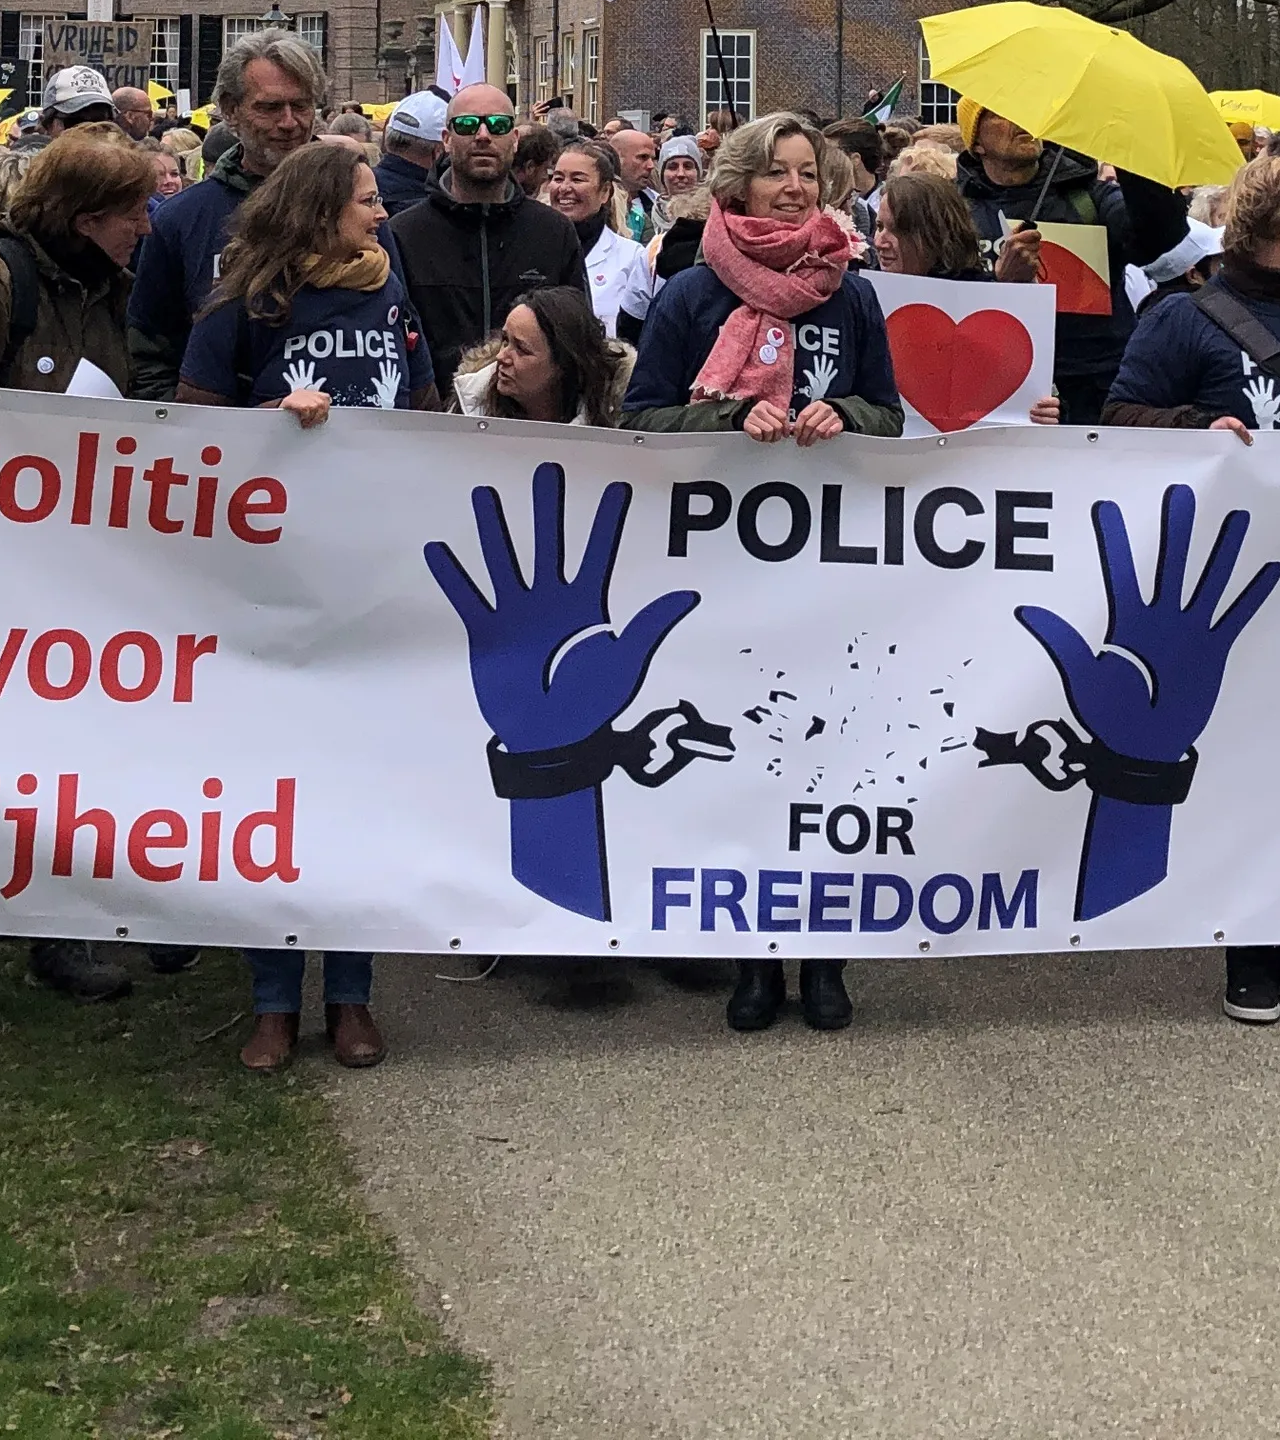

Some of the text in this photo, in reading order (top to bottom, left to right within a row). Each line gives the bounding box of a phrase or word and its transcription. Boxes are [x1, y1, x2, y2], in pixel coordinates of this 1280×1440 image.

[47, 23, 138, 57] VRIJHEID
[283, 329, 399, 360] POLICE
[667, 480, 1054, 572] POLICE
[788, 802, 916, 856] FOR
[651, 867, 1040, 935] FREEDOM
